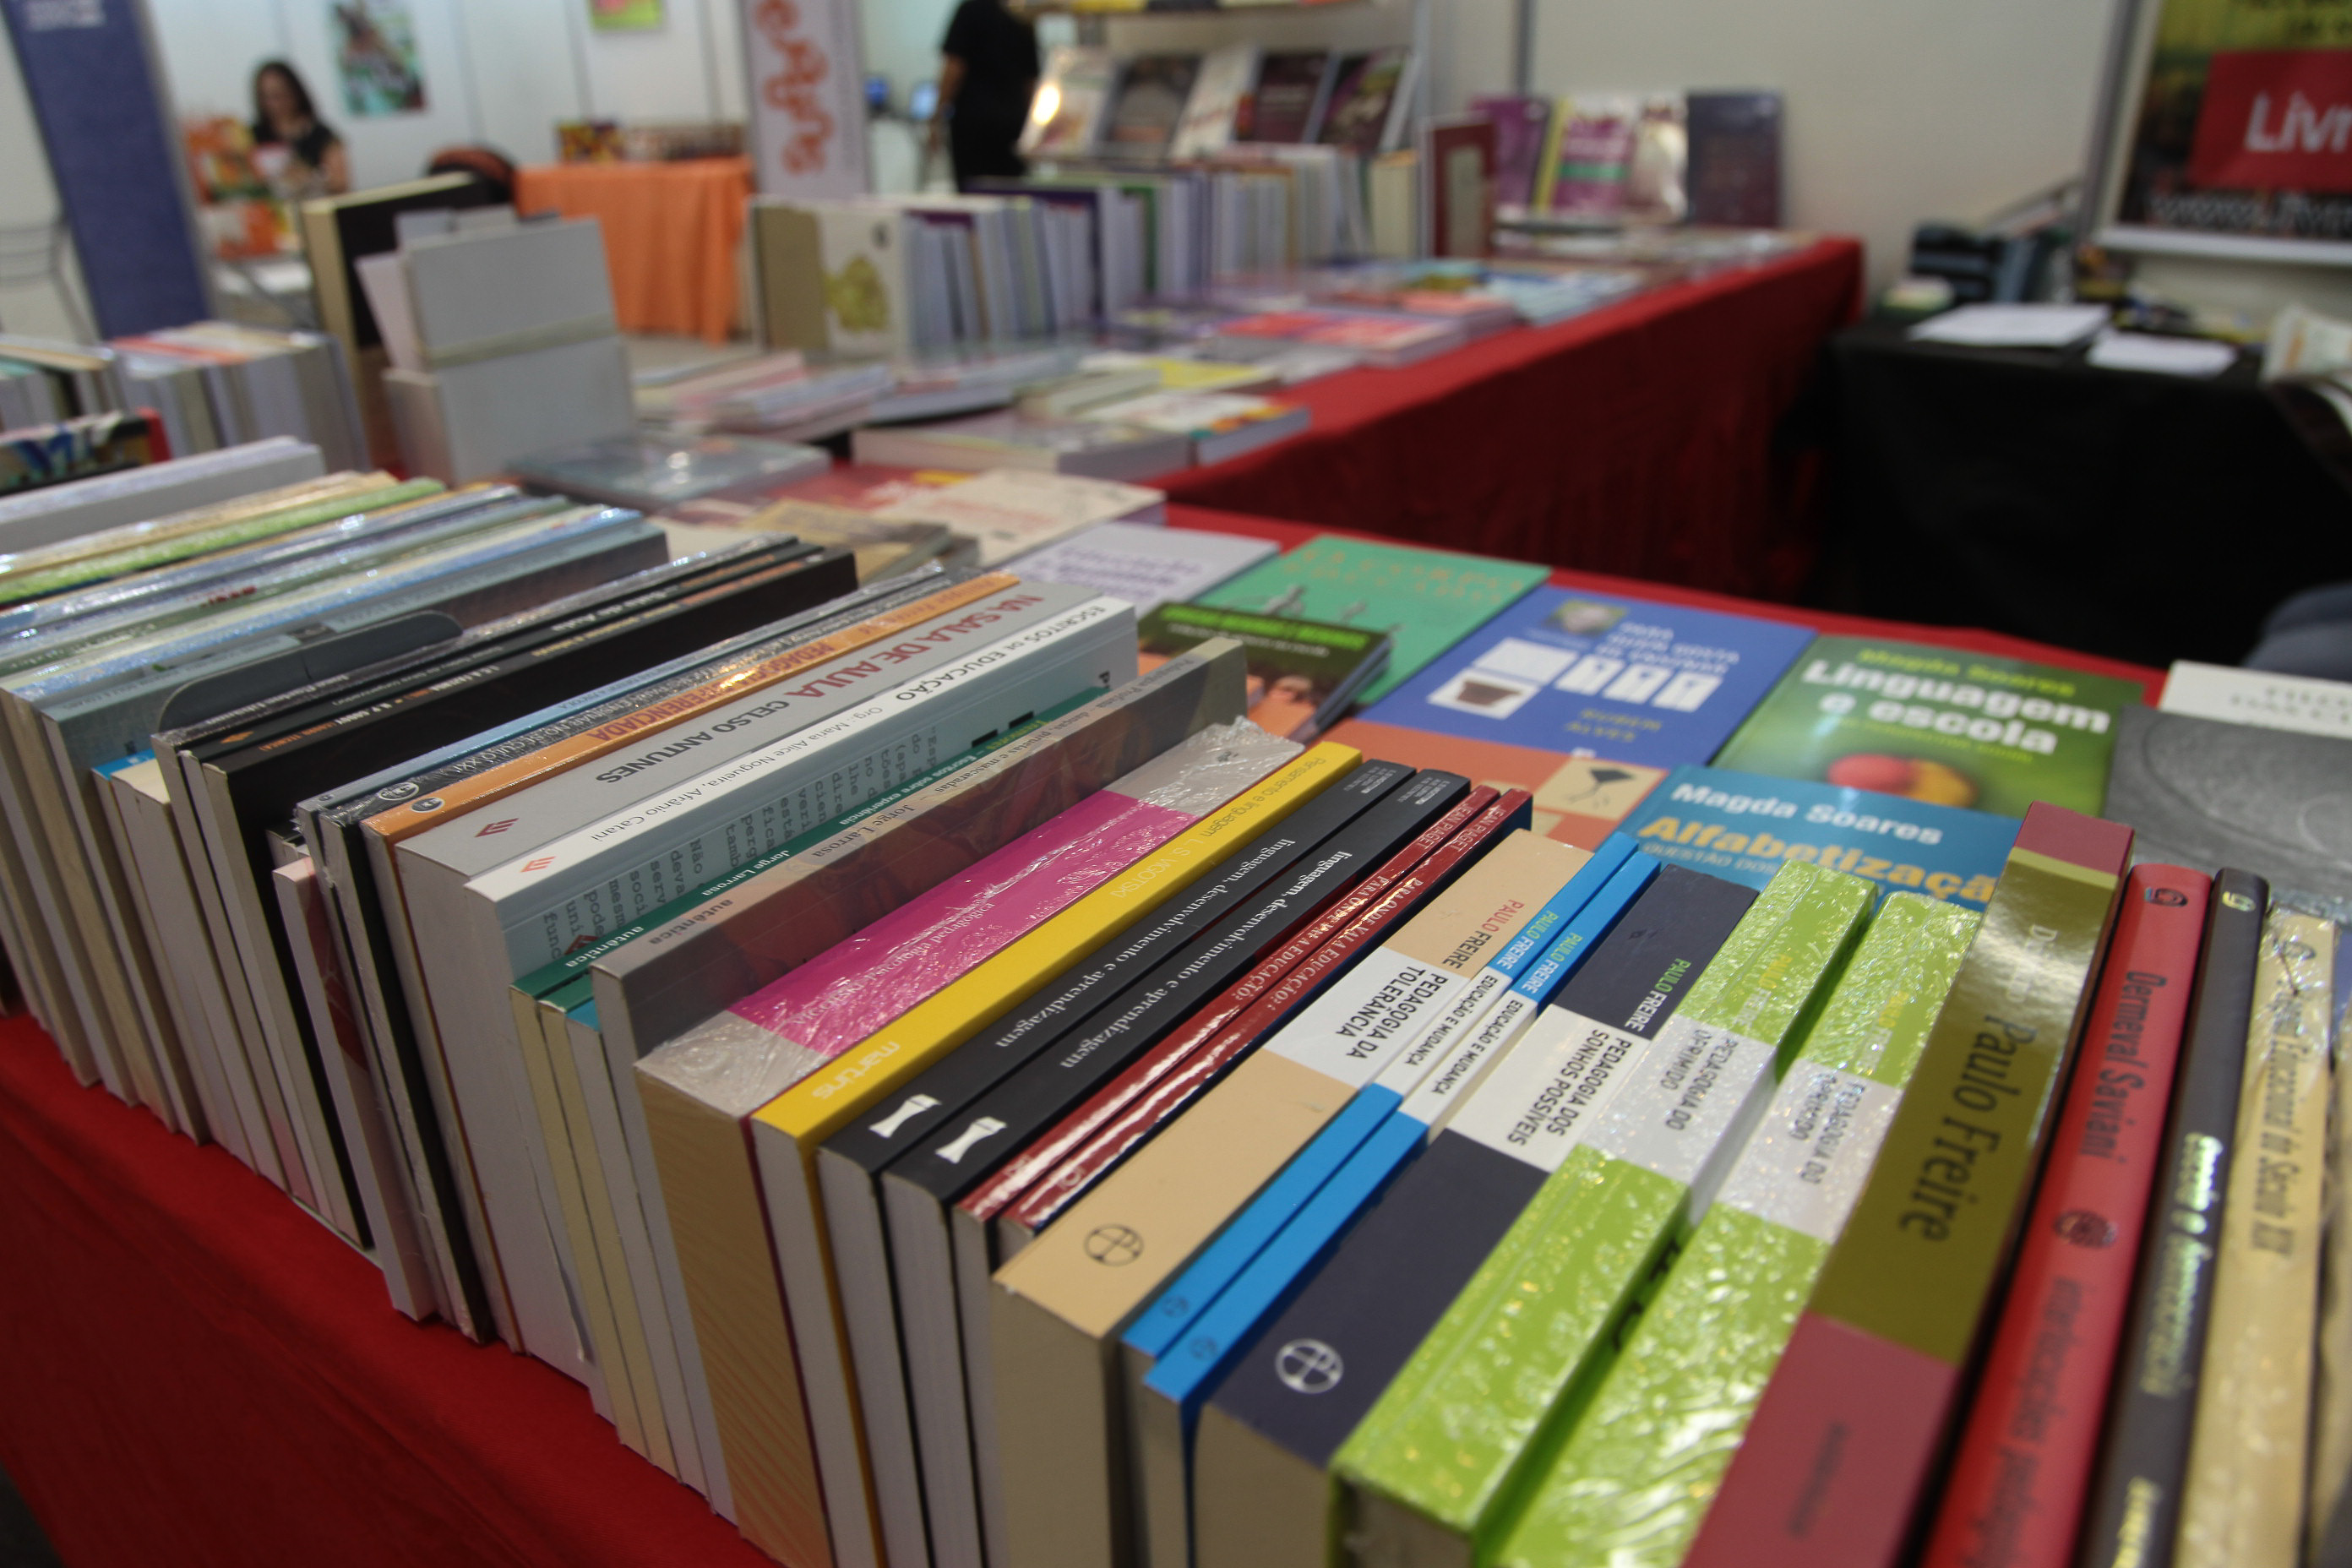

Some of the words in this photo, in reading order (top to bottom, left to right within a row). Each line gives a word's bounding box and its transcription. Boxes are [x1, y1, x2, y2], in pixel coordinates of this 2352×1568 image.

[986, 594, 1045, 612] NA
[916, 612, 1002, 643] SALA
[1025, 605, 1107, 643] ESCRITOS
[871, 642, 932, 664] DE
[785, 660, 883, 699] AULA
[896, 651, 1006, 700] EDUCAÇÃO
[1800, 659, 2110, 734] Linguagem
[712, 700, 790, 733] CELSO
[809, 721, 850, 742] Maria
[1819, 692, 1856, 716] e
[1868, 700, 2058, 755] escola
[596, 732, 714, 784] ANTUNES
[776, 739, 808, 757] Alice
[865, 755, 874, 777] no
[702, 754, 776, 787] Nogueira,
[901, 776, 934, 794] sobre
[934, 757, 999, 793] mascaradas
[1262, 757, 1326, 796] Pensamento
[645, 787, 703, 816] Afrânio
[872, 803, 916, 827] Jorge
[1255, 794, 1266, 803] e
[1446, 804, 1473, 826] JEAN
[1670, 782, 1798, 819] Magda
[1805, 804, 1944, 845] Soares
[591, 815, 645, 842] Catani
[780, 797, 796, 840] está
[1200, 801, 1260, 837] linguagem
[1480, 807, 1507, 827] JEAN
[725, 823, 742, 868] tamb
[740, 814, 759, 859] perg
[812, 825, 876, 858] Larrosa
[1417, 823, 1455, 850] PIAGET
[1450, 825, 1487, 852] PIAGET
[670, 850, 686, 896] deva
[689, 838, 703, 874] Não
[754, 849, 791, 869] Jorge
[1224, 838, 1296, 883] linguagem,
[650, 860, 666, 904] serv
[700, 867, 755, 896] Larrosa
[1109, 854, 1174, 898] VIGOTSKI
[1281, 851, 1353, 898] linguagem,
[1358, 875, 1391, 897] PARA
[649, 899, 733, 945] autêntica
[1116, 883, 1228, 962] desenvolvimento
[1365, 901, 1398, 926] ONDE
[1482, 899, 1525, 932] PAULO
[1527, 910, 1560, 939] PAULO
[565, 925, 645, 969] autêntica
[1179, 897, 1288, 979] desenvolvimento
[1331, 939, 1347, 950] A
[1345, 924, 1369, 943] VAI
[1442, 930, 1493, 970] FREIRE
[1550, 932, 1583, 962] PAULO
[1104, 963, 1117, 972] e
[1496, 936, 1535, 970] FREIRE
[1166, 980, 1179, 988] e
[1231, 945, 1305, 1001] EDUCAÇÃO?
[1522, 960, 1560, 994] FREIRE
[1656, 957, 1692, 993] PAULO
[1758, 955, 1794, 989] PAULO
[995, 967, 1105, 1048] aprendizagem
[1335, 966, 1427, 1037] TOLERÂNCIA
[1367, 972, 1449, 1040] PEDAGOGIA
[1454, 975, 1499, 1018] EDUCAÇÃO
[1624, 990, 1667, 1032] FREIRE
[1059, 987, 1168, 1068] aprendizagem
[1445, 1017, 1459, 1026] E
[1478, 999, 1524, 1046] EDUCAÇÃO
[2104, 971, 2168, 1070] Dermeval
[1346, 1040, 1380, 1060] DA
[1404, 1024, 1451, 1066] MUDANÇA
[1472, 1044, 1485, 1053] E
[1560, 1028, 1609, 1079] SONHOS
[1659, 1028, 1713, 1091] OPRIMIDO
[812, 1041, 901, 1099] martins
[1431, 1051, 1478, 1095] MUDANÇA
[1568, 1037, 1633, 1107] PEDAGOGIA
[1680, 1037, 1739, 1109] PEDAGOGIA
[1952, 1015, 2039, 1113] Paulo
[1545, 1107, 1580, 1136] DOS
[1665, 1108, 1692, 1131] DO
[1814, 1081, 1866, 1159] PEDAGOGIA
[2080, 1069, 2146, 1165] Saviani
[1800, 1161, 1827, 1184] DO
[1898, 1116, 2001, 1242] Freire
